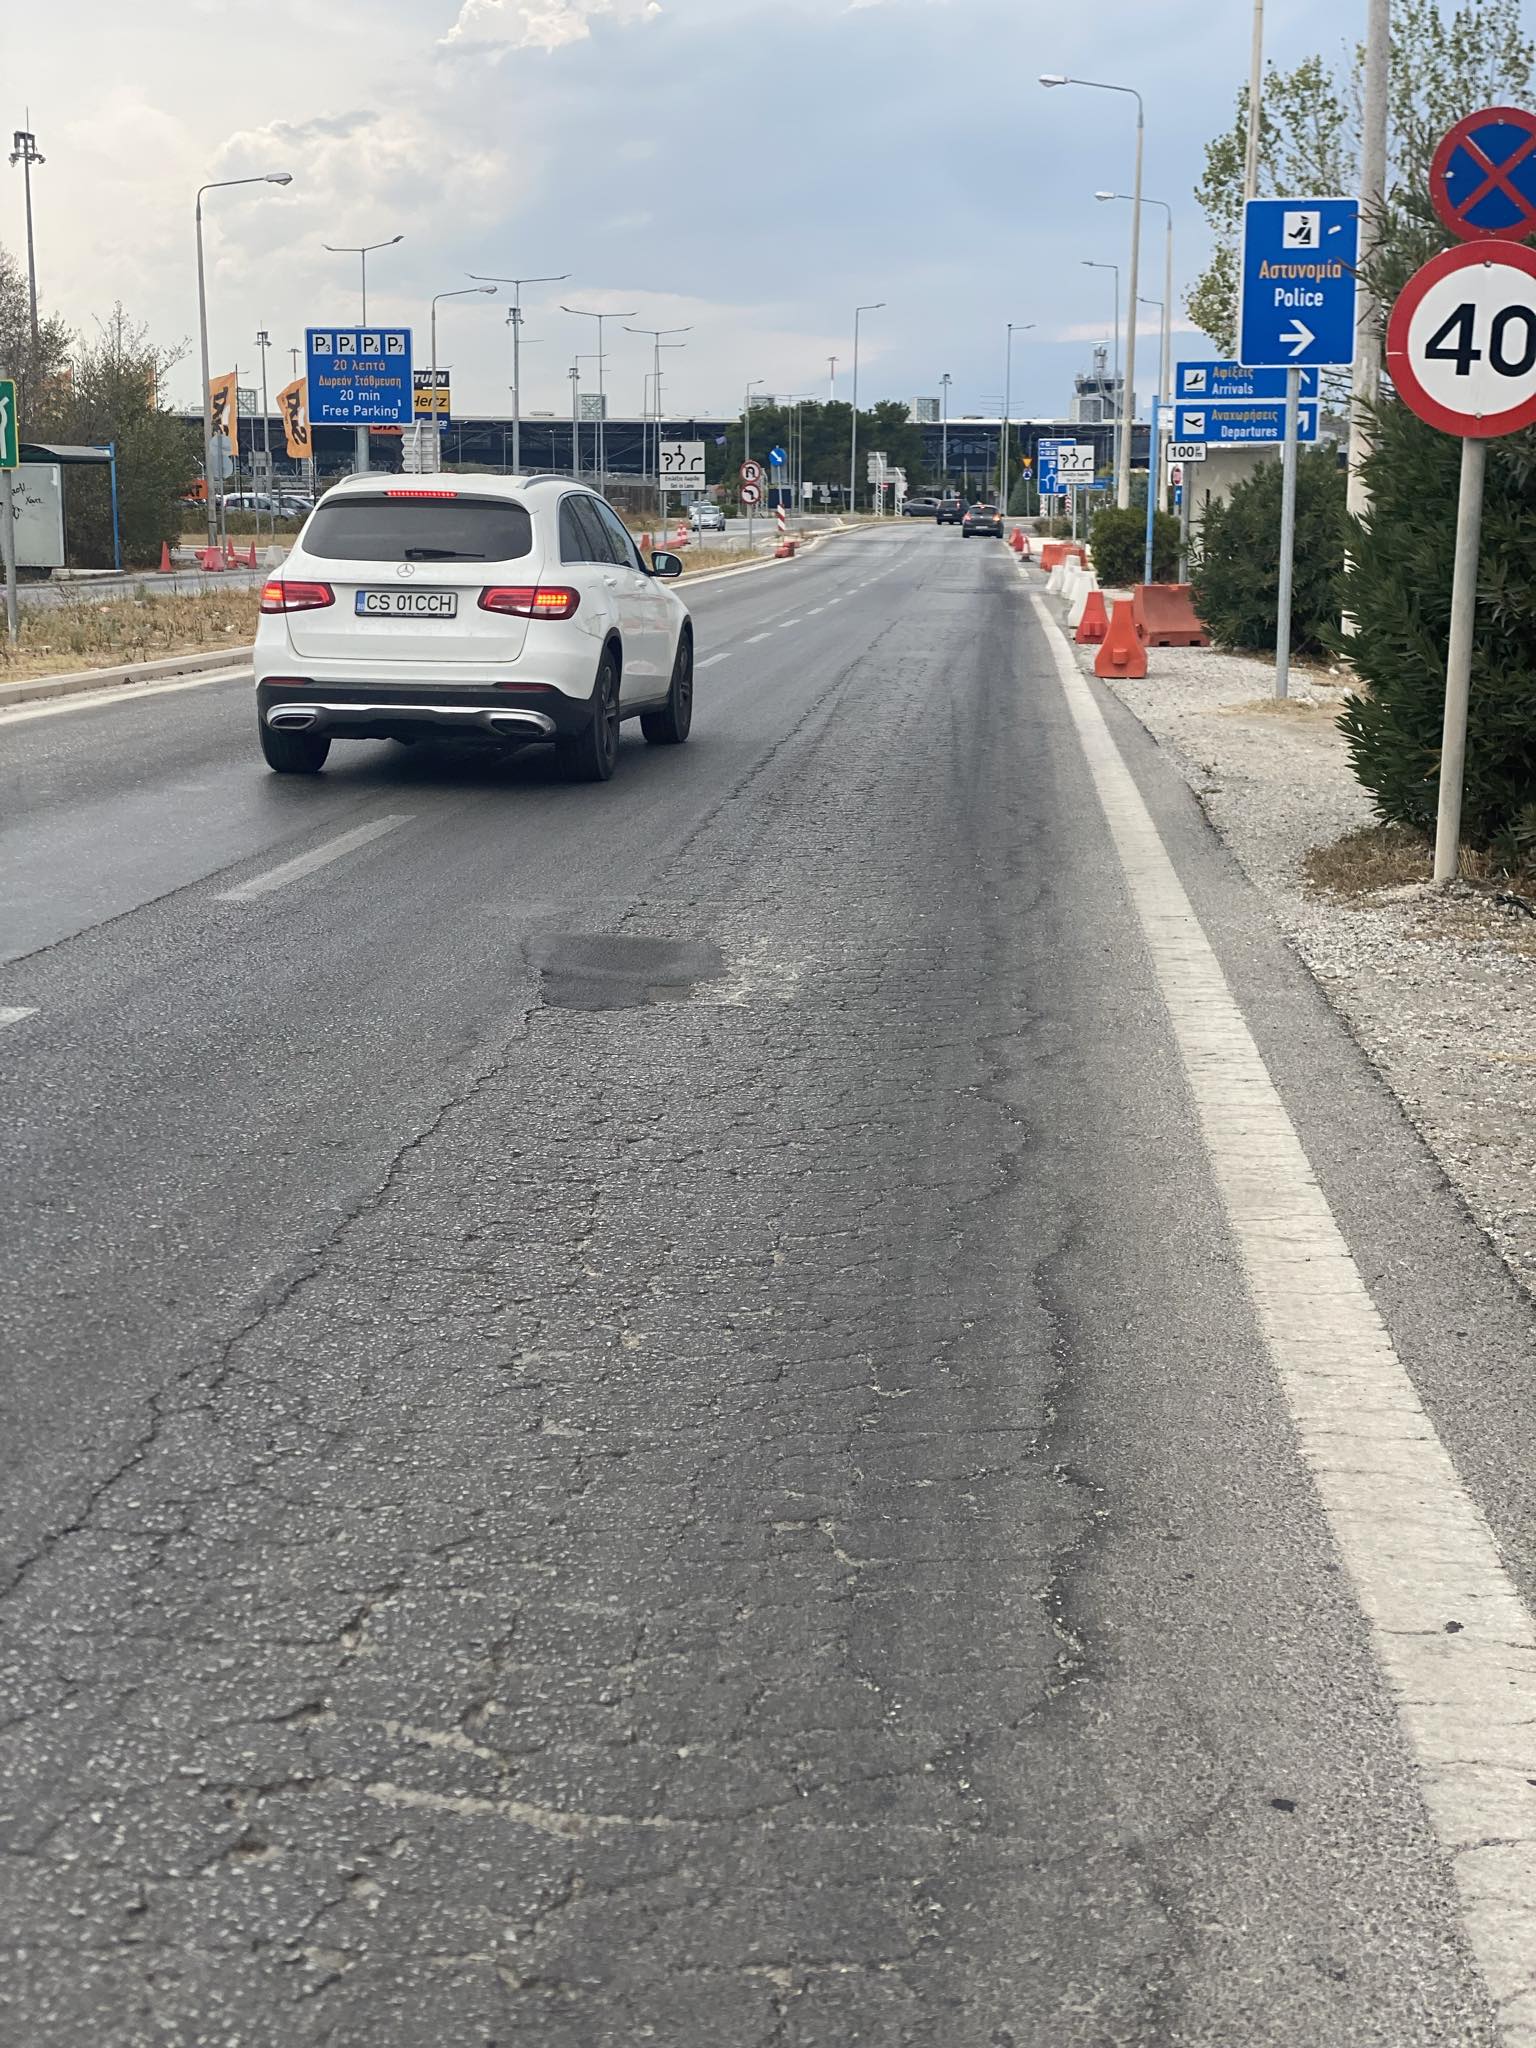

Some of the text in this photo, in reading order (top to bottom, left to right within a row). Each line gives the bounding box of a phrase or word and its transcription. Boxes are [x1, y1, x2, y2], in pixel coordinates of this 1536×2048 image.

[1259, 259, 1342, 283] Αστυνομία
[1274, 288, 1324, 307] Police
[315, 337, 403, 352] P3 P4 P6 P7
[1424, 303, 1536, 378] 40
[333, 360, 386, 371] 20 λεπτά
[319, 375, 401, 389] Δωρεάν Στάθμευση
[1212, 383, 1254, 395] Arrivals
[340, 390, 380, 401] 20 min
[414, 395, 447, 406] Herz
[322, 405, 399, 419] Free Parking
[1211, 408, 1279, 422] Αναχωρήσεις
[1221, 426, 1278, 439] Departures
[1171, 446, 1194, 457] 100
[367, 594, 391, 610] CS
